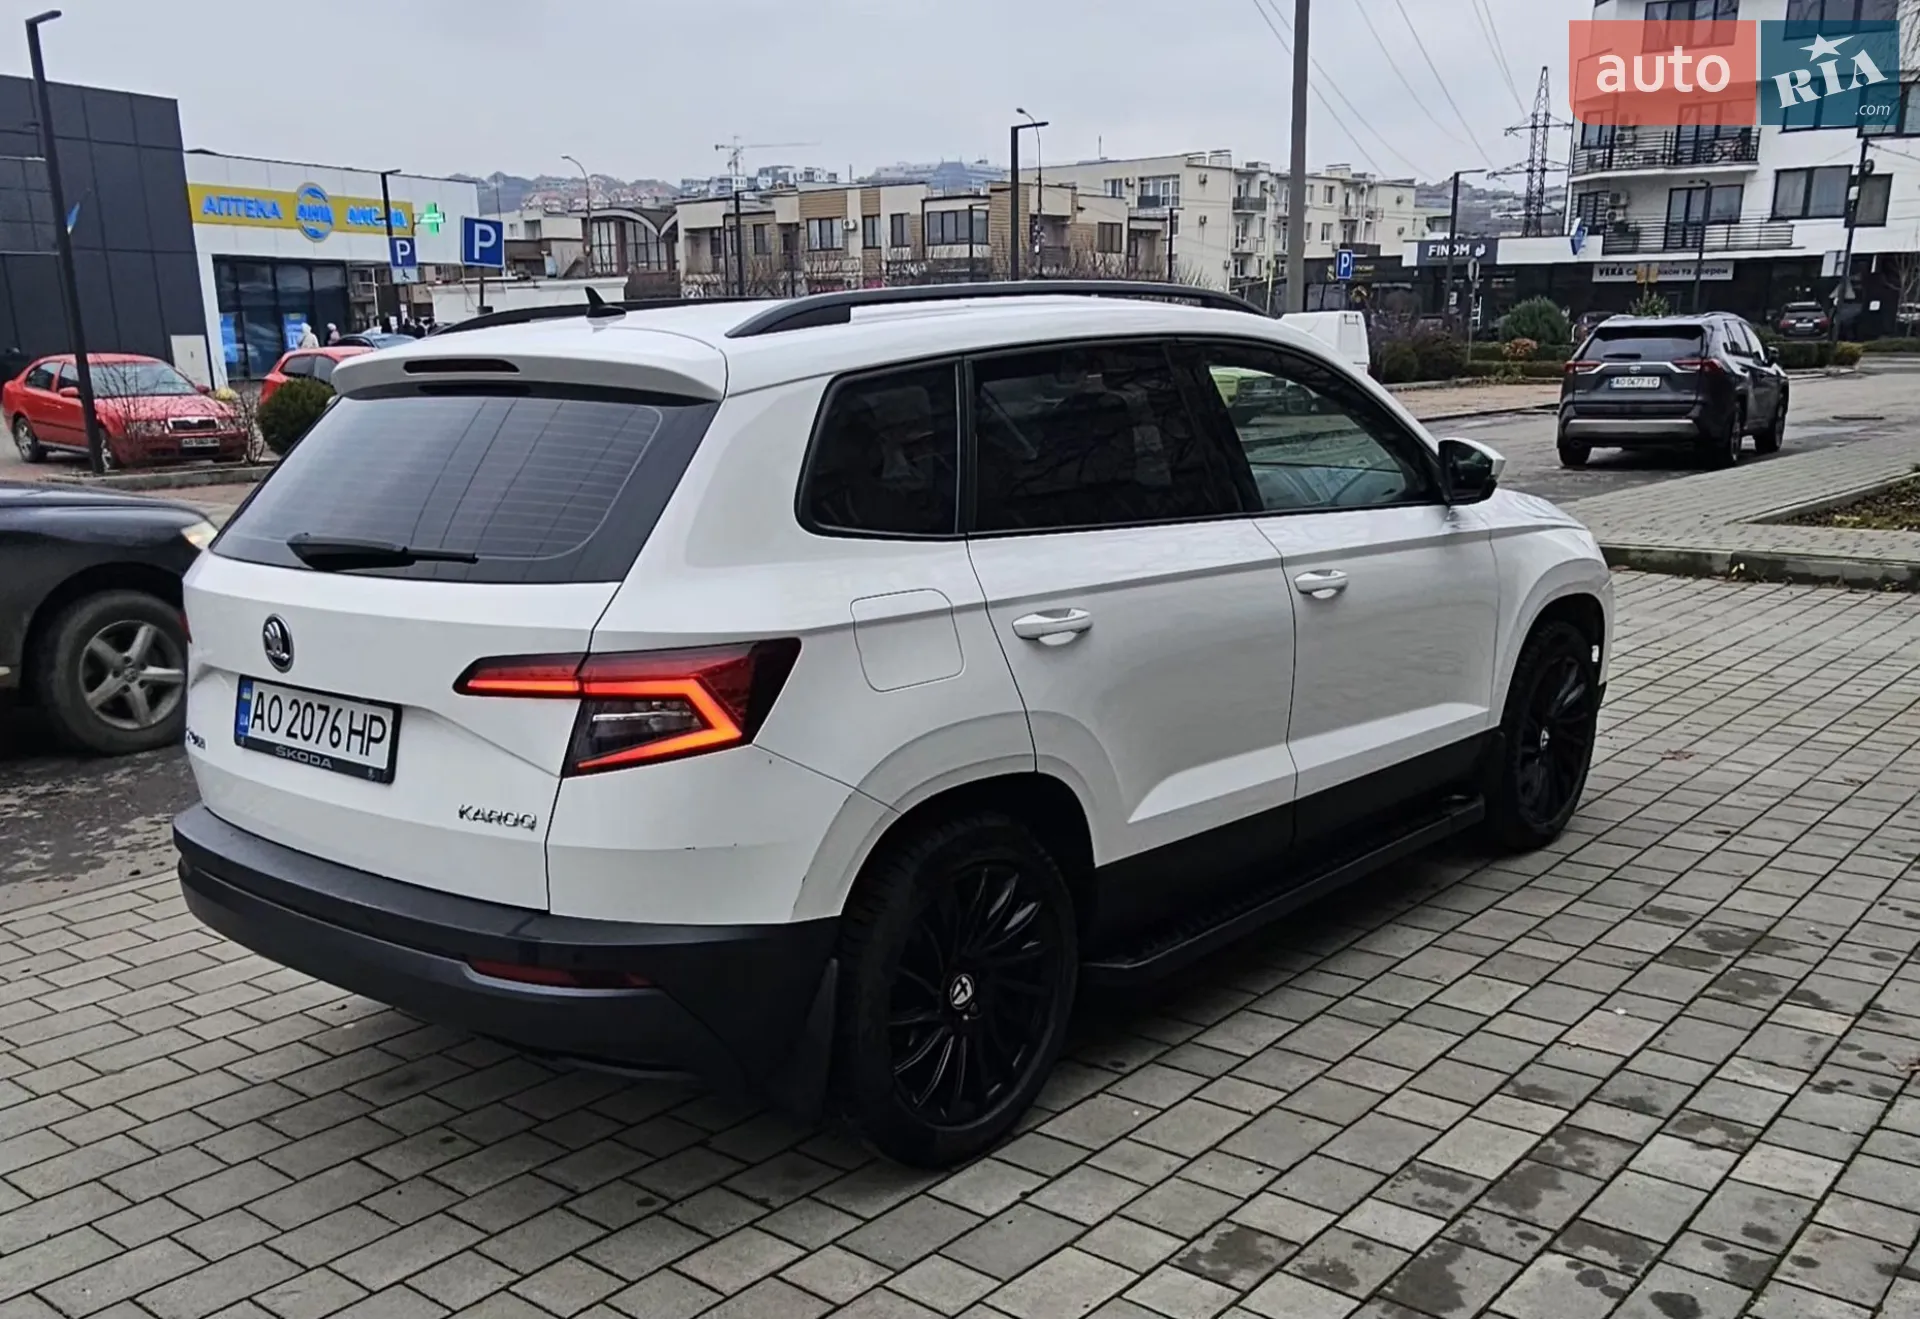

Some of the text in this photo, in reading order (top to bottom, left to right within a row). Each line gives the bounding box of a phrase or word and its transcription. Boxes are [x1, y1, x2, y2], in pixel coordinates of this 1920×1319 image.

[202, 195, 283, 220] АПТЕКА
[396, 240, 411, 265] P
[473, 222, 497, 260] P
[1340, 253, 1350, 276] P
[251, 691, 387, 757] AO 2076 HP
